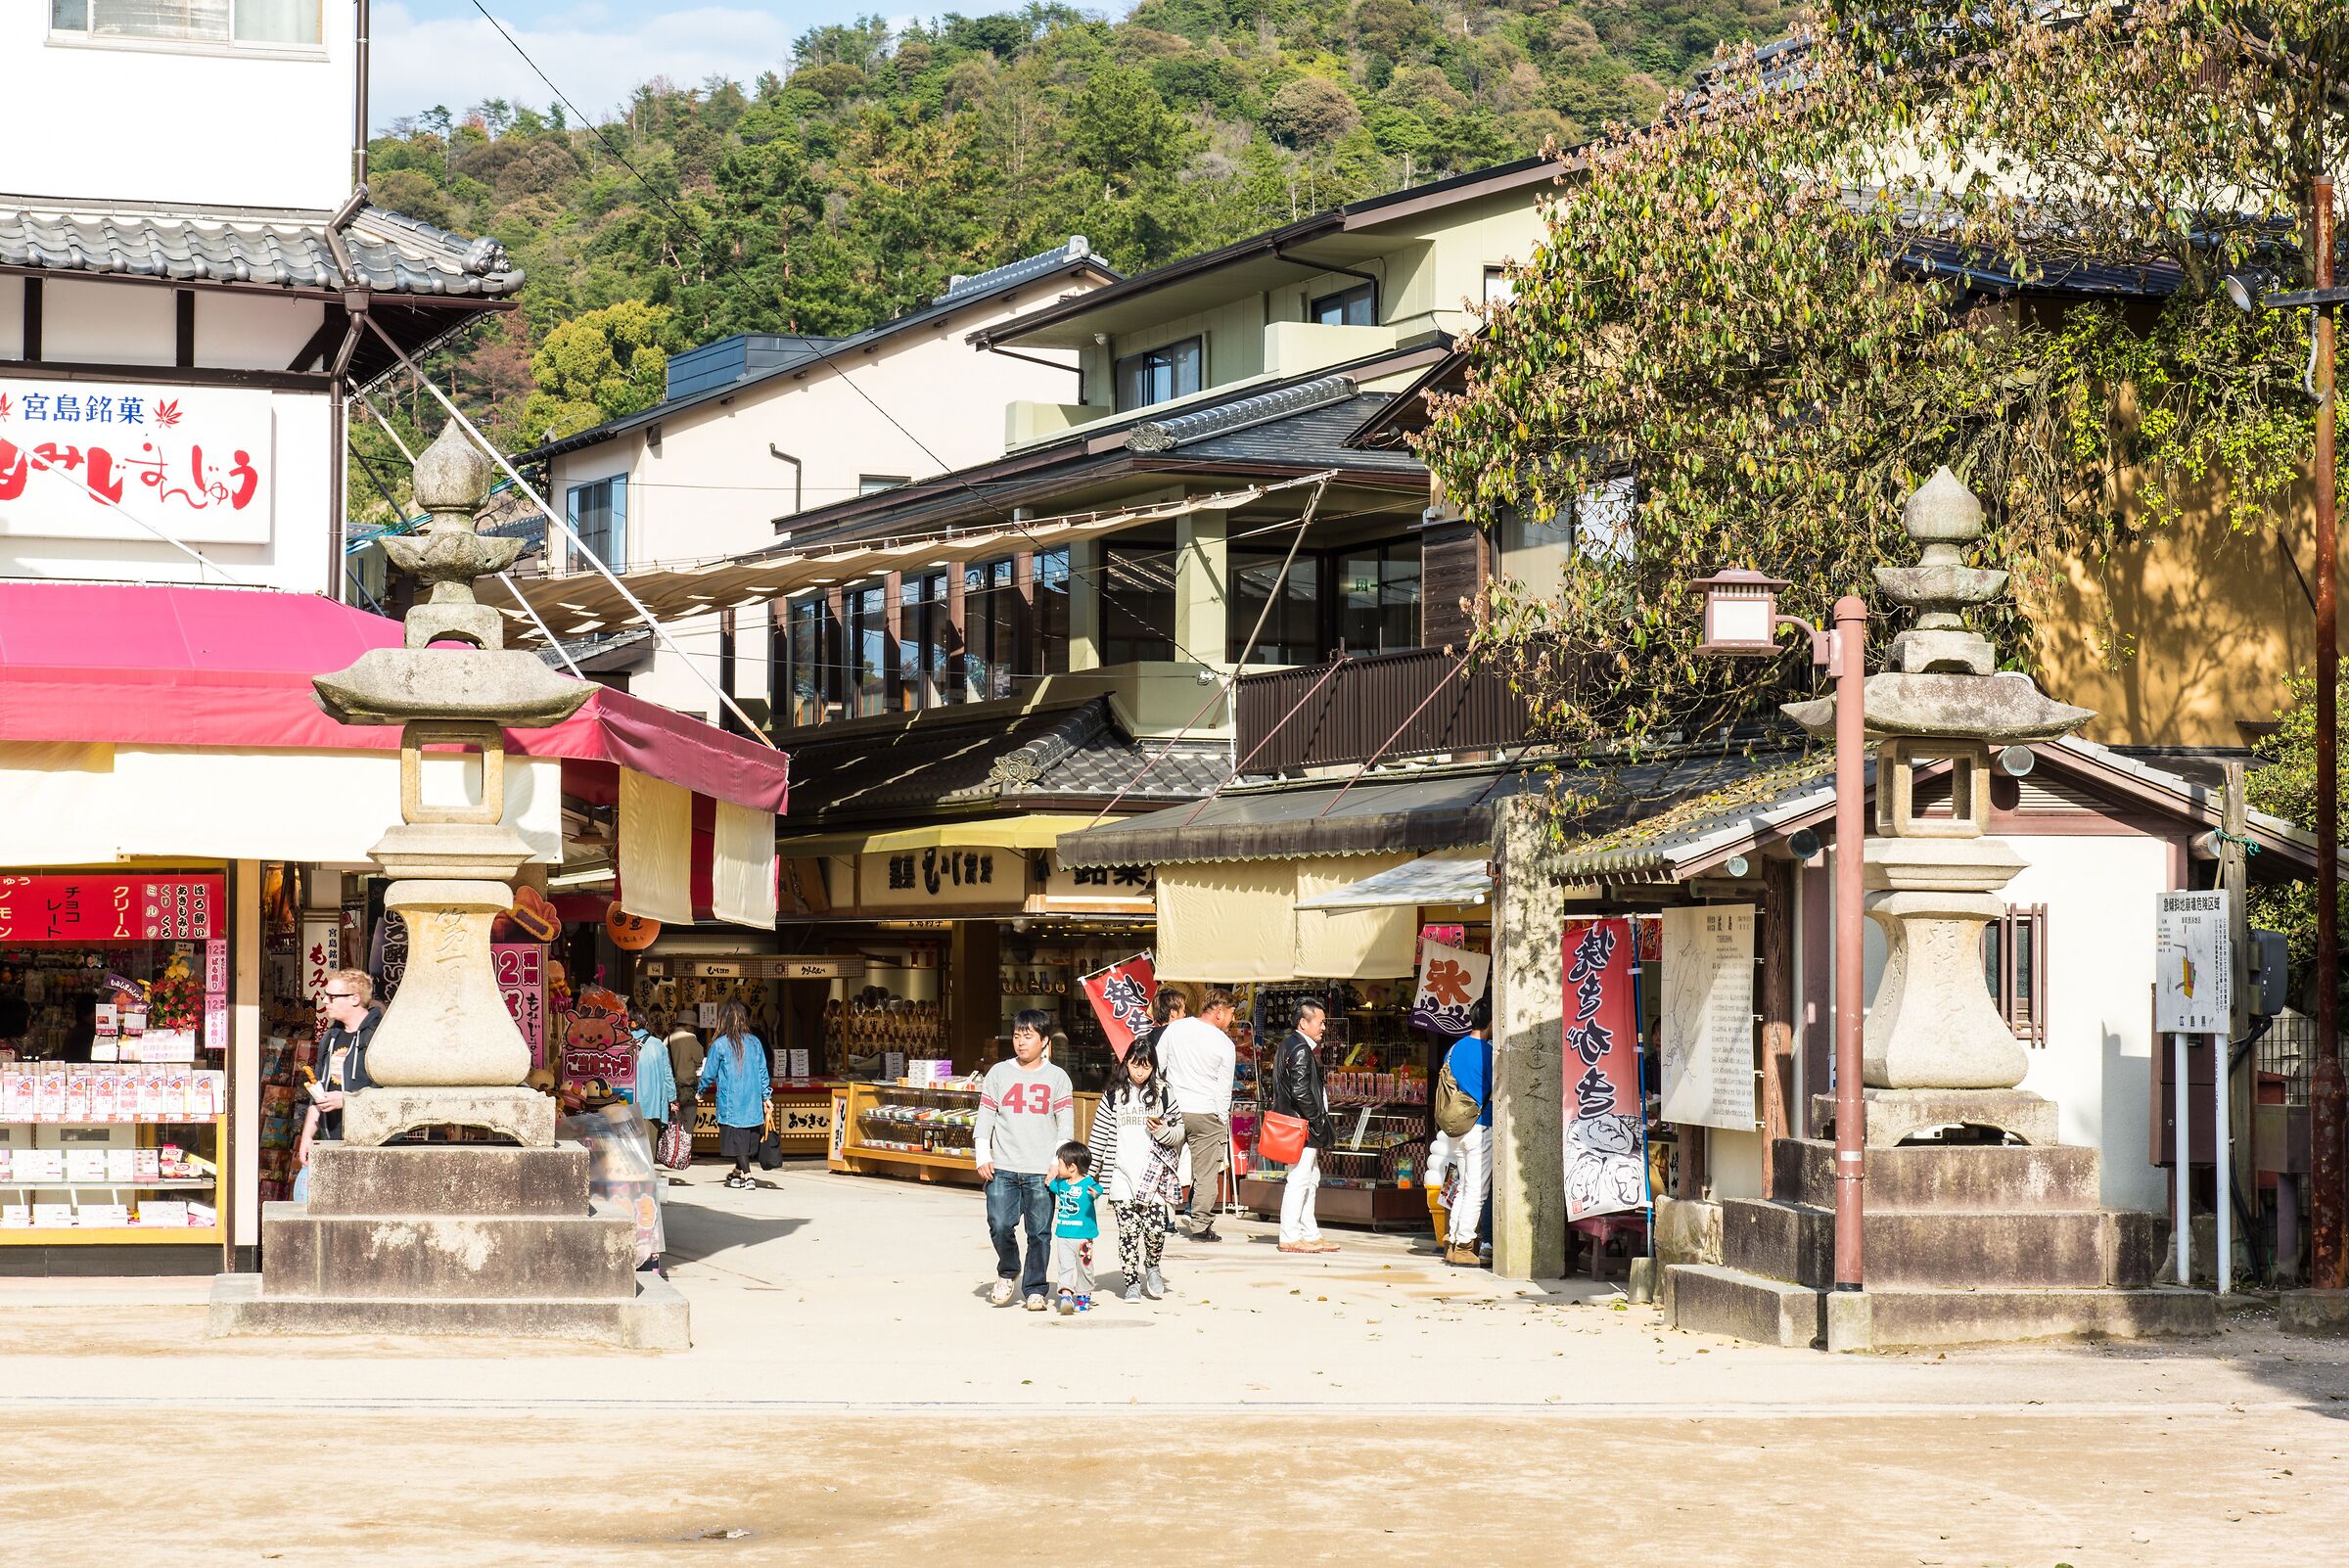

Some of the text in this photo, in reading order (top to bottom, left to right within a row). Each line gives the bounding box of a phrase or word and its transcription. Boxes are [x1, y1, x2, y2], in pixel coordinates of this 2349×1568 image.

[23, 392, 145, 424] 宮島銘菓
[47, 899, 63, 939] レート
[65, 886, 81, 923] チョコ
[113, 886, 131, 938] クリーム
[147, 885, 159, 938] ミルク
[176, 885, 189, 938] あきもみじ
[194, 885, 206, 938] ほろ酔い
[2163, 898, 2220, 912] 急傾斜地崩壊危険区域
[328, 928, 338, 970] 宮島銘菓
[1424, 958, 1472, 1006] 氷
[1568, 920, 1616, 1121] 焼きがき
[566, 1053, 633, 1078] ご当地キャラ
[1001, 1083, 1051, 1115] 43
